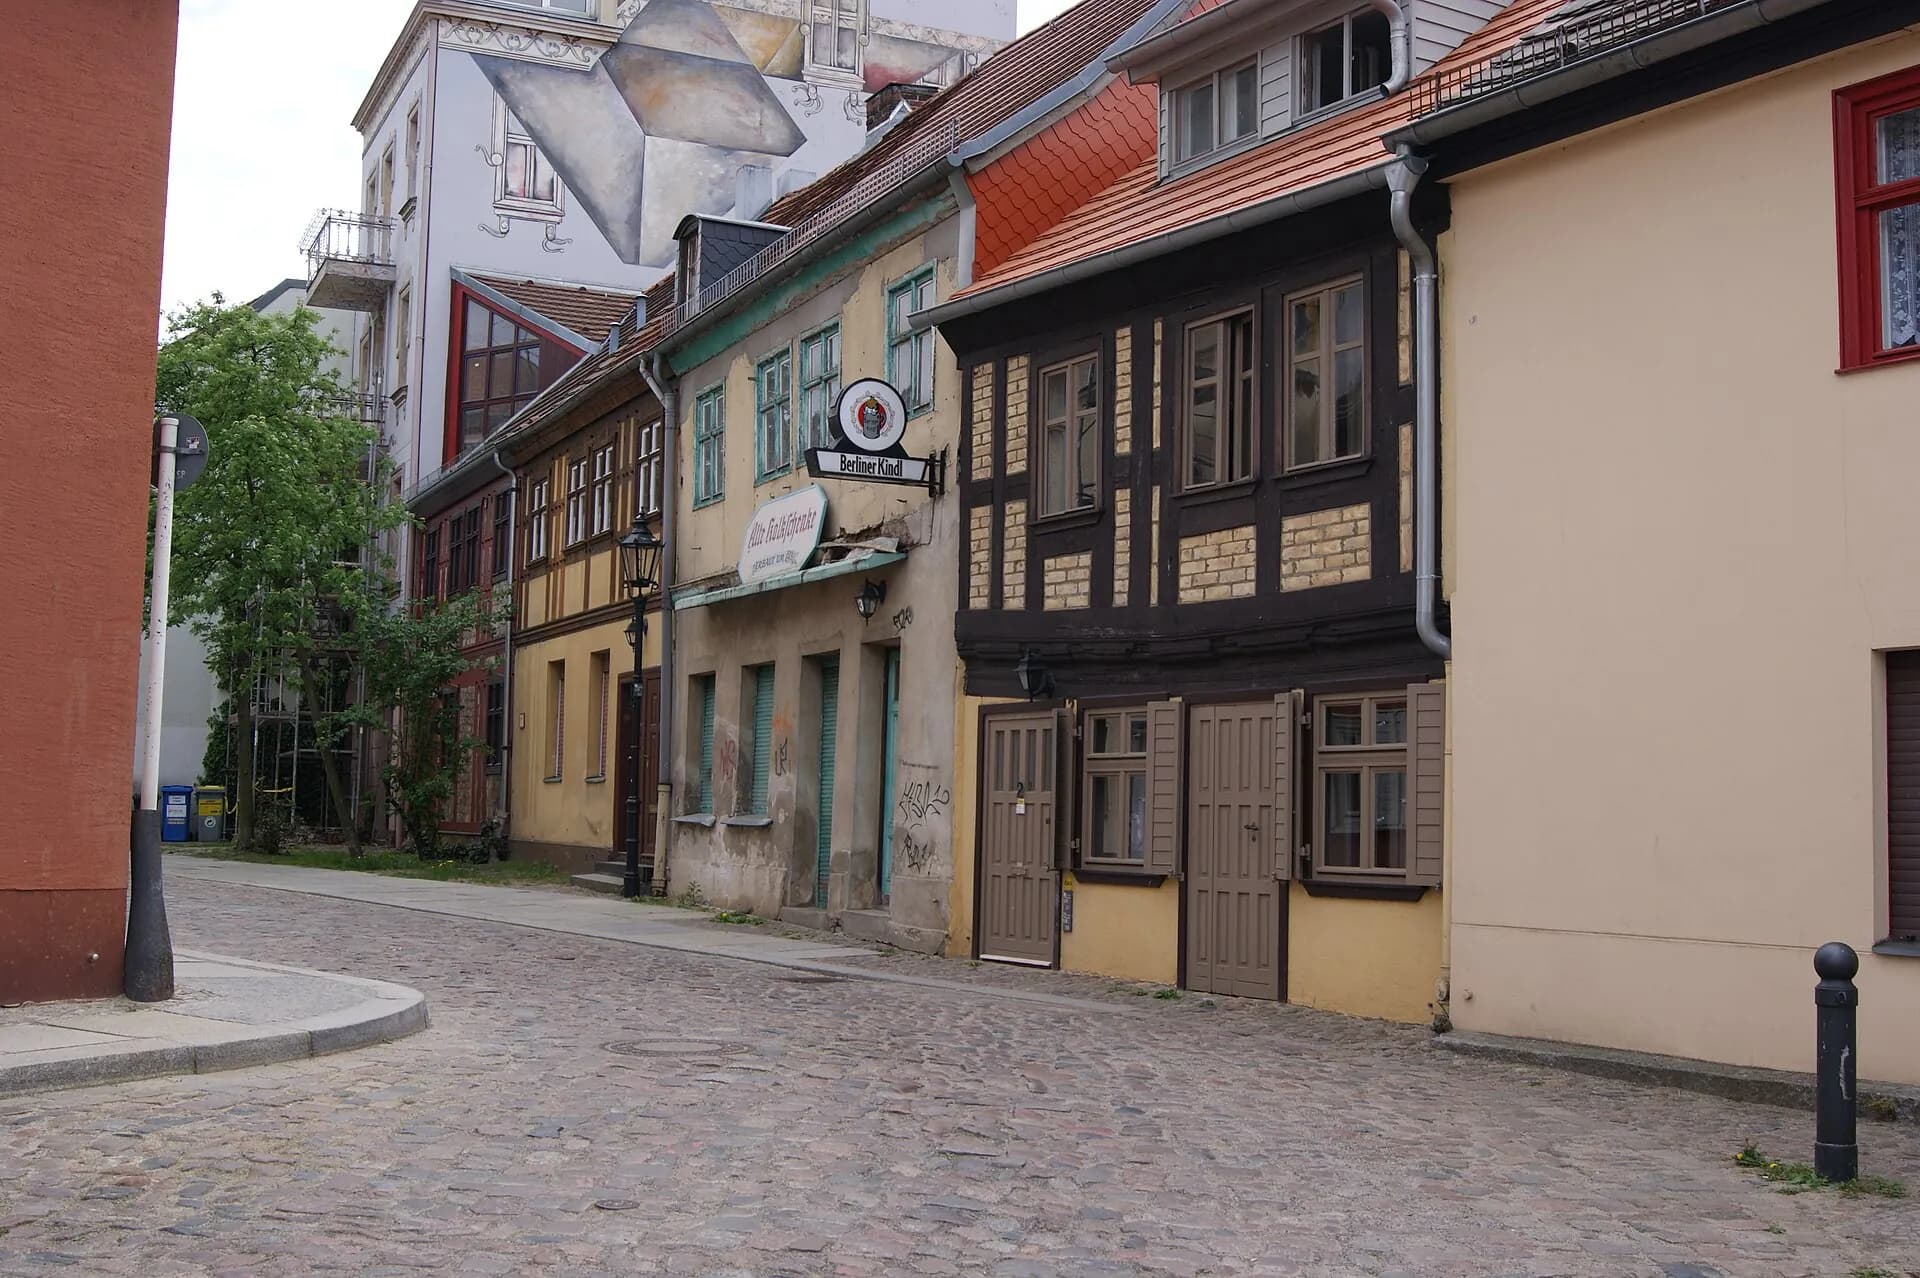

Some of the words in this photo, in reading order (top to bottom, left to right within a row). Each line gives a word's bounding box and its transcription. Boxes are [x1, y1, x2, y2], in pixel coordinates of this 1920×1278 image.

[840, 454, 877, 474] Berliner
[877, 458, 903, 477] Kindl
[1016, 781, 1025, 798] 2
